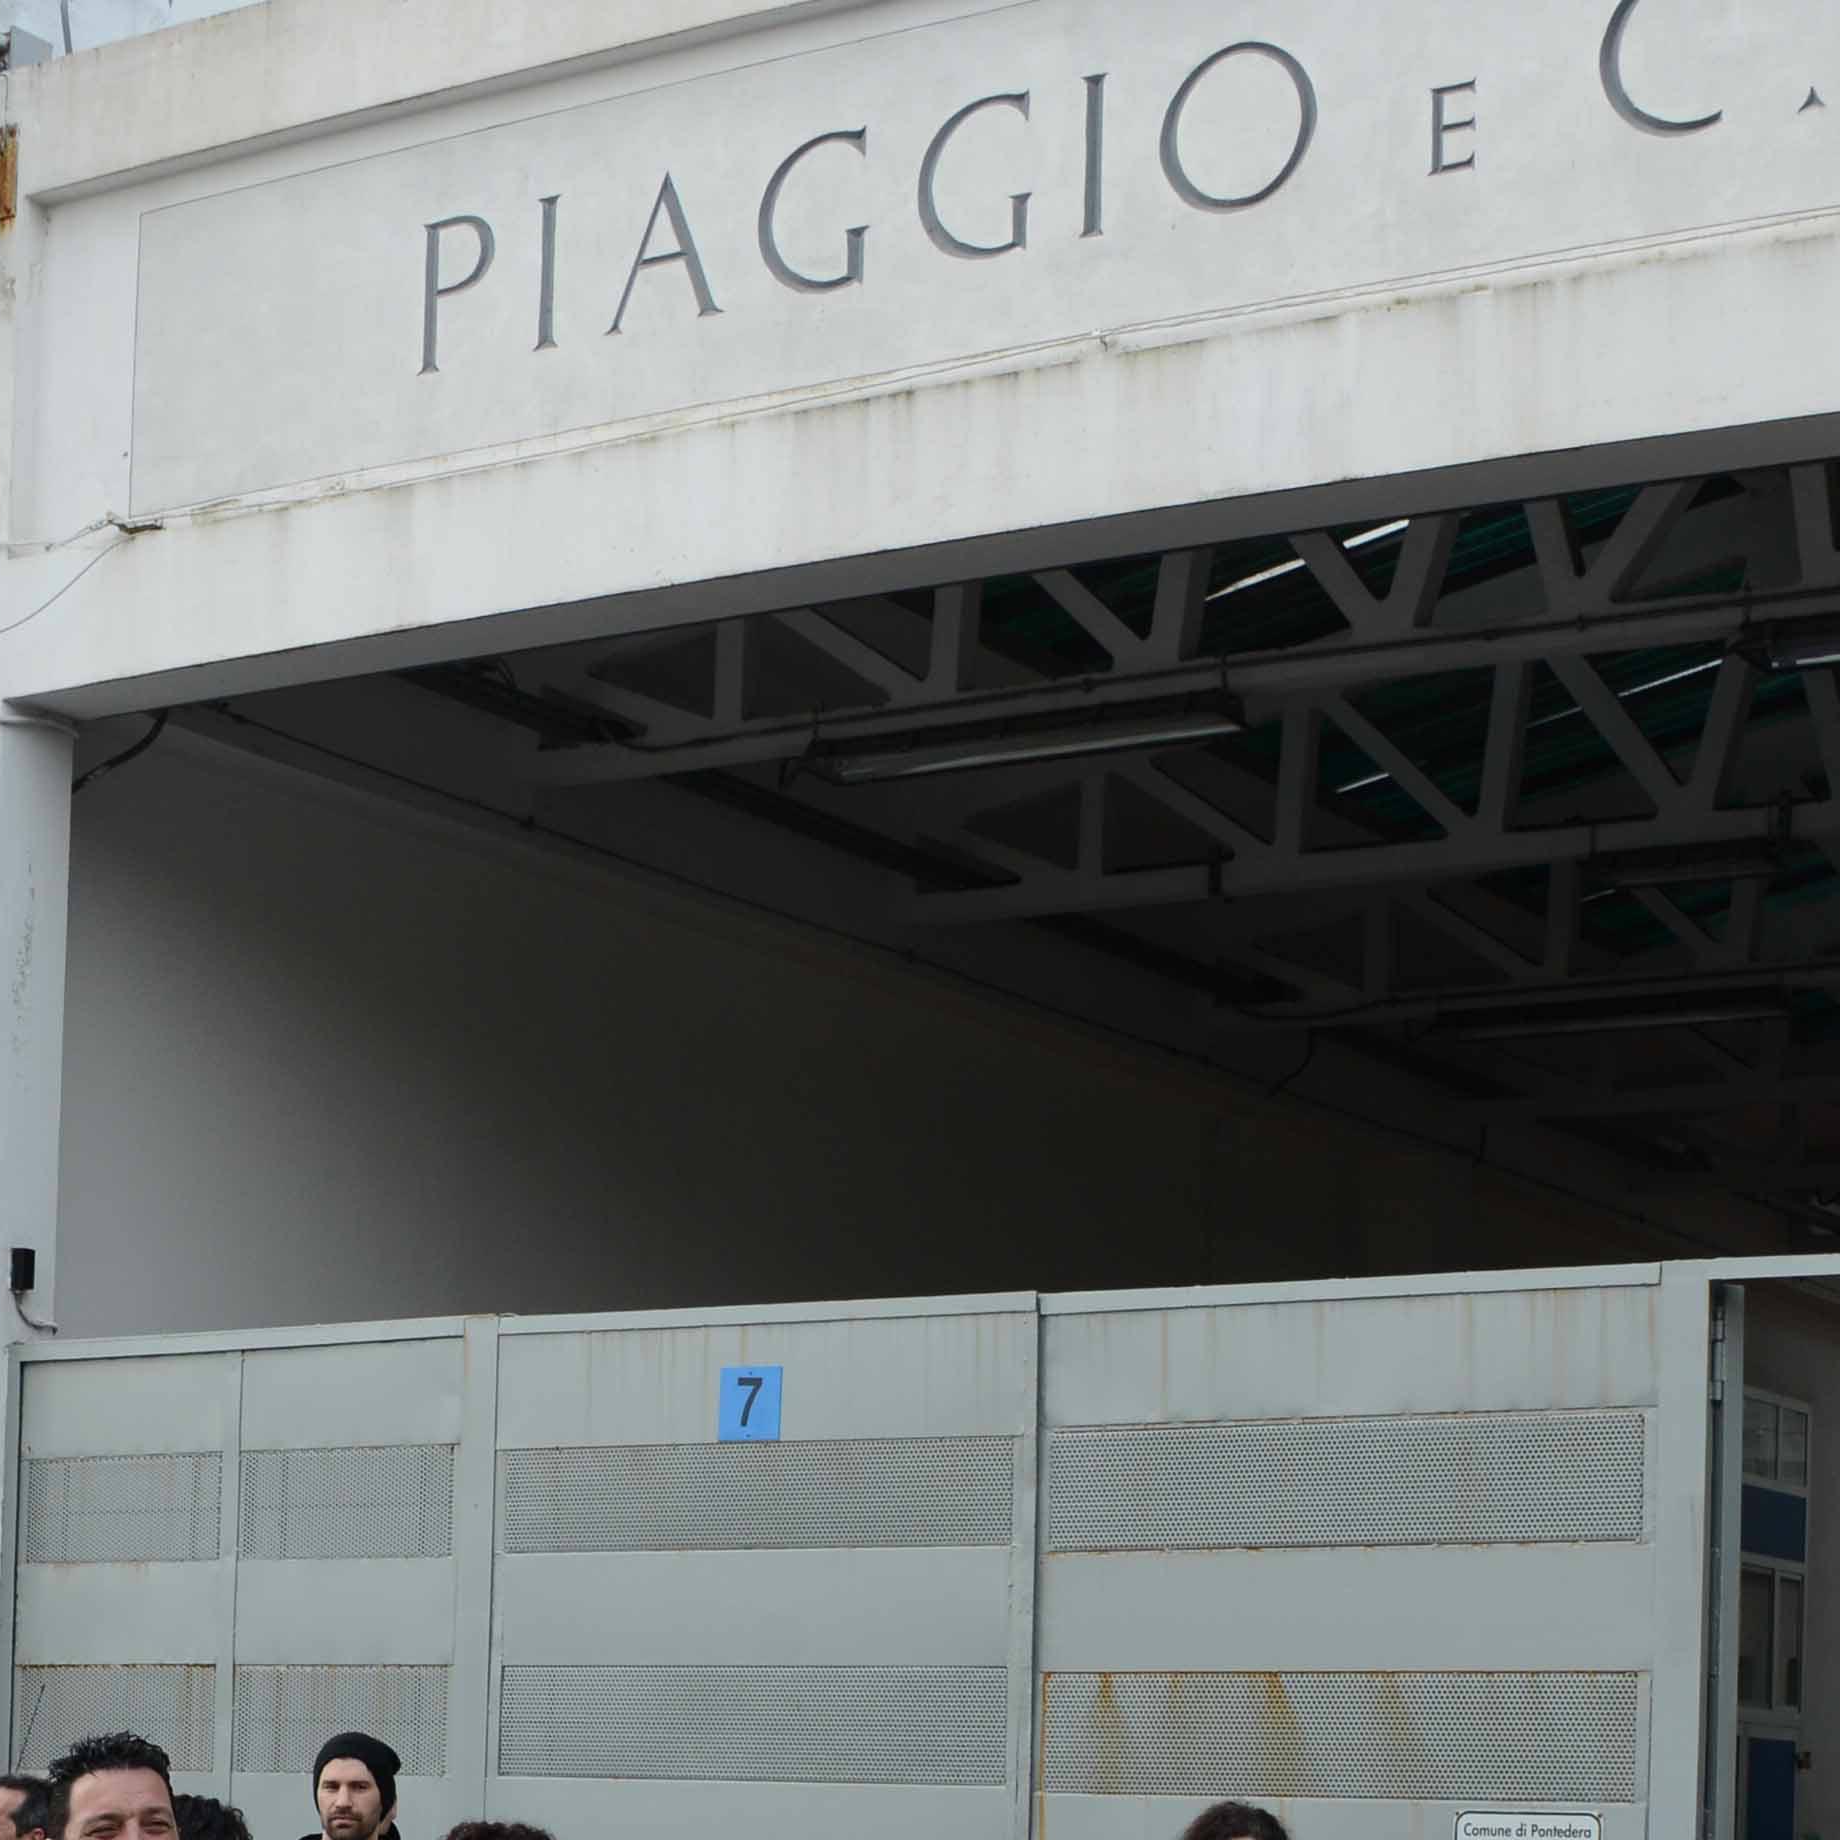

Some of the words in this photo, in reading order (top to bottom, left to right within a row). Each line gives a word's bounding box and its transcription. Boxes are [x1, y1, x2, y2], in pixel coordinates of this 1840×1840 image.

[417, 40, 1319, 375] PIAGGIO
[1427, 77, 1478, 178] E
[736, 1376, 764, 1428] 7
[1463, 1822, 1512, 1838] Comune
[1515, 1823, 1528, 1838] di
[1530, 1823, 1593, 1840] Pontedera
